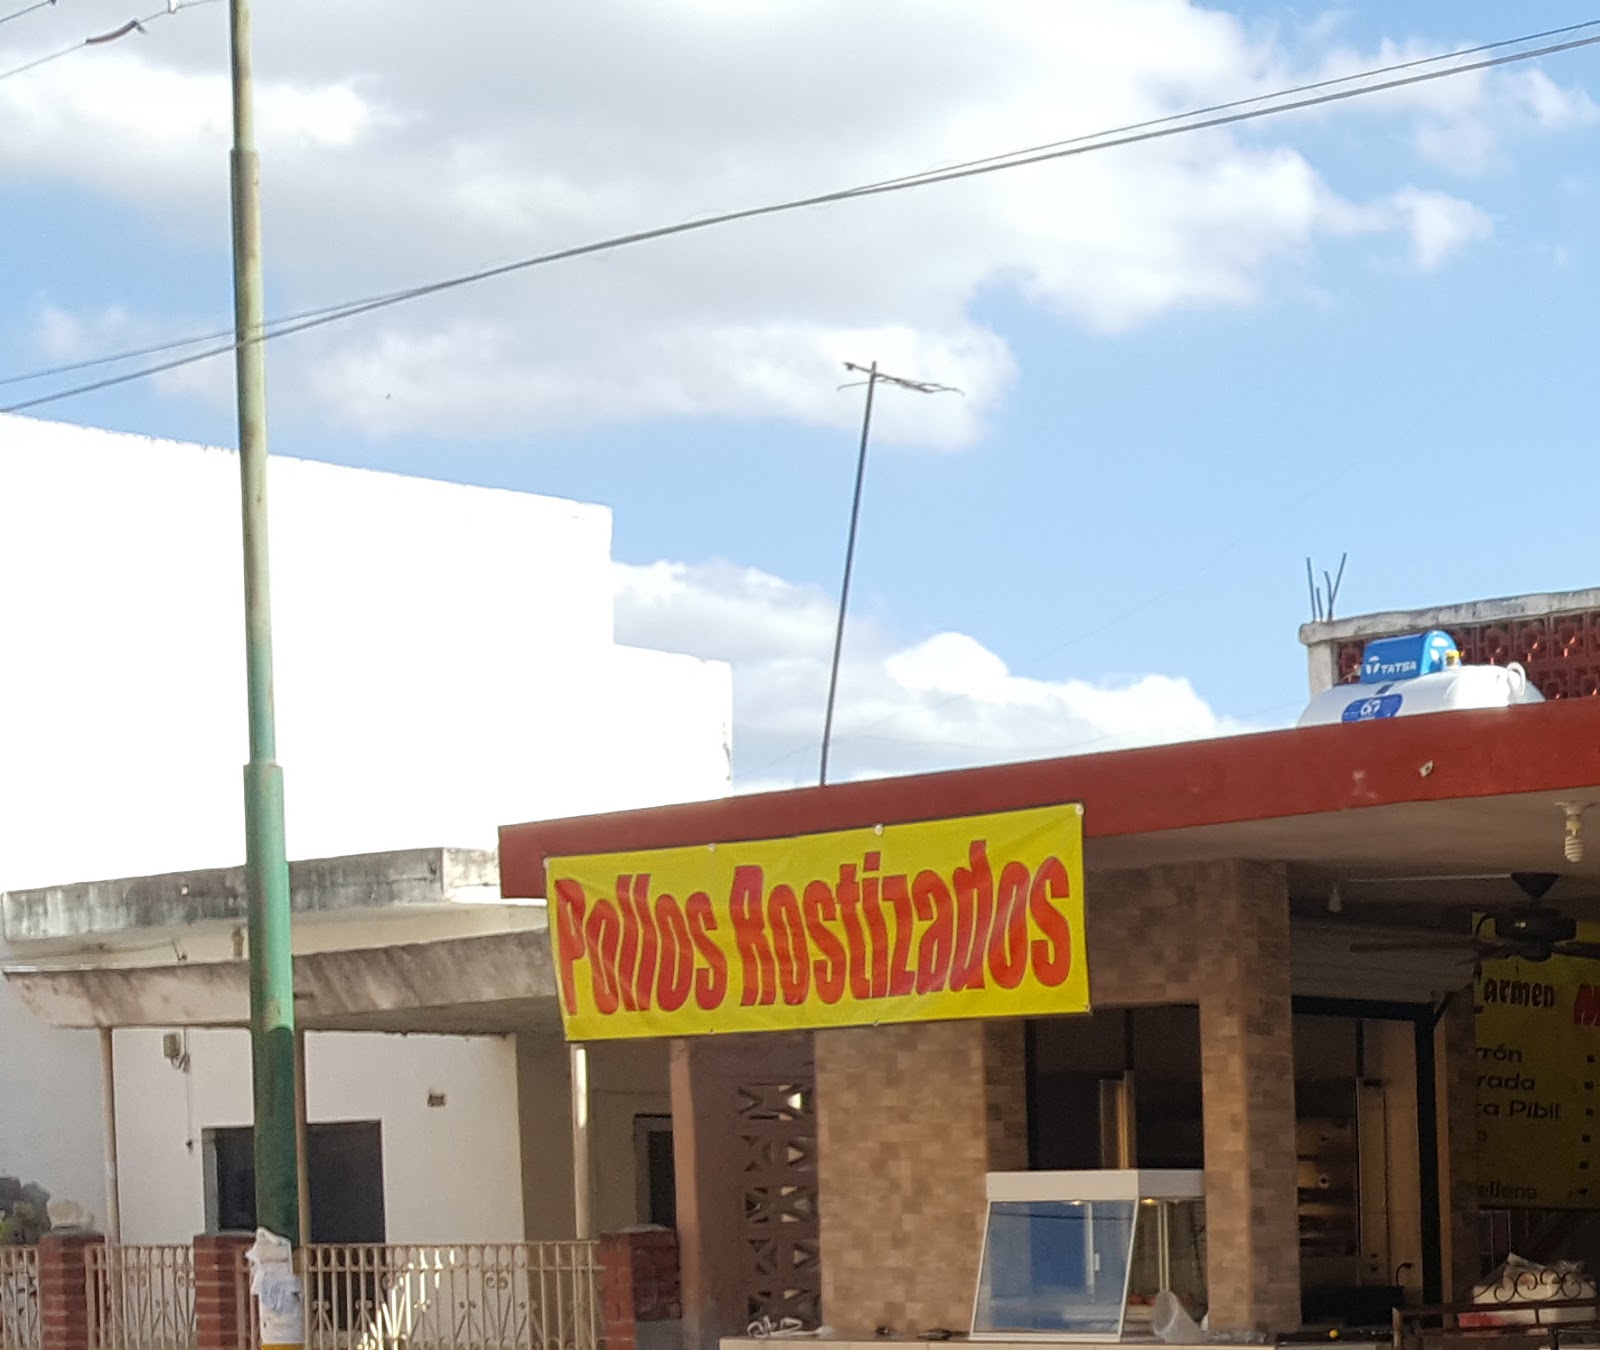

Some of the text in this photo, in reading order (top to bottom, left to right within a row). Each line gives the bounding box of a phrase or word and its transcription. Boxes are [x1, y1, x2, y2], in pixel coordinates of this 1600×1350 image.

[1381, 660, 1417, 674] TATSA
[555, 839, 1071, 1015] Pollos Rostizados
[1477, 972, 1556, 1009] armen
